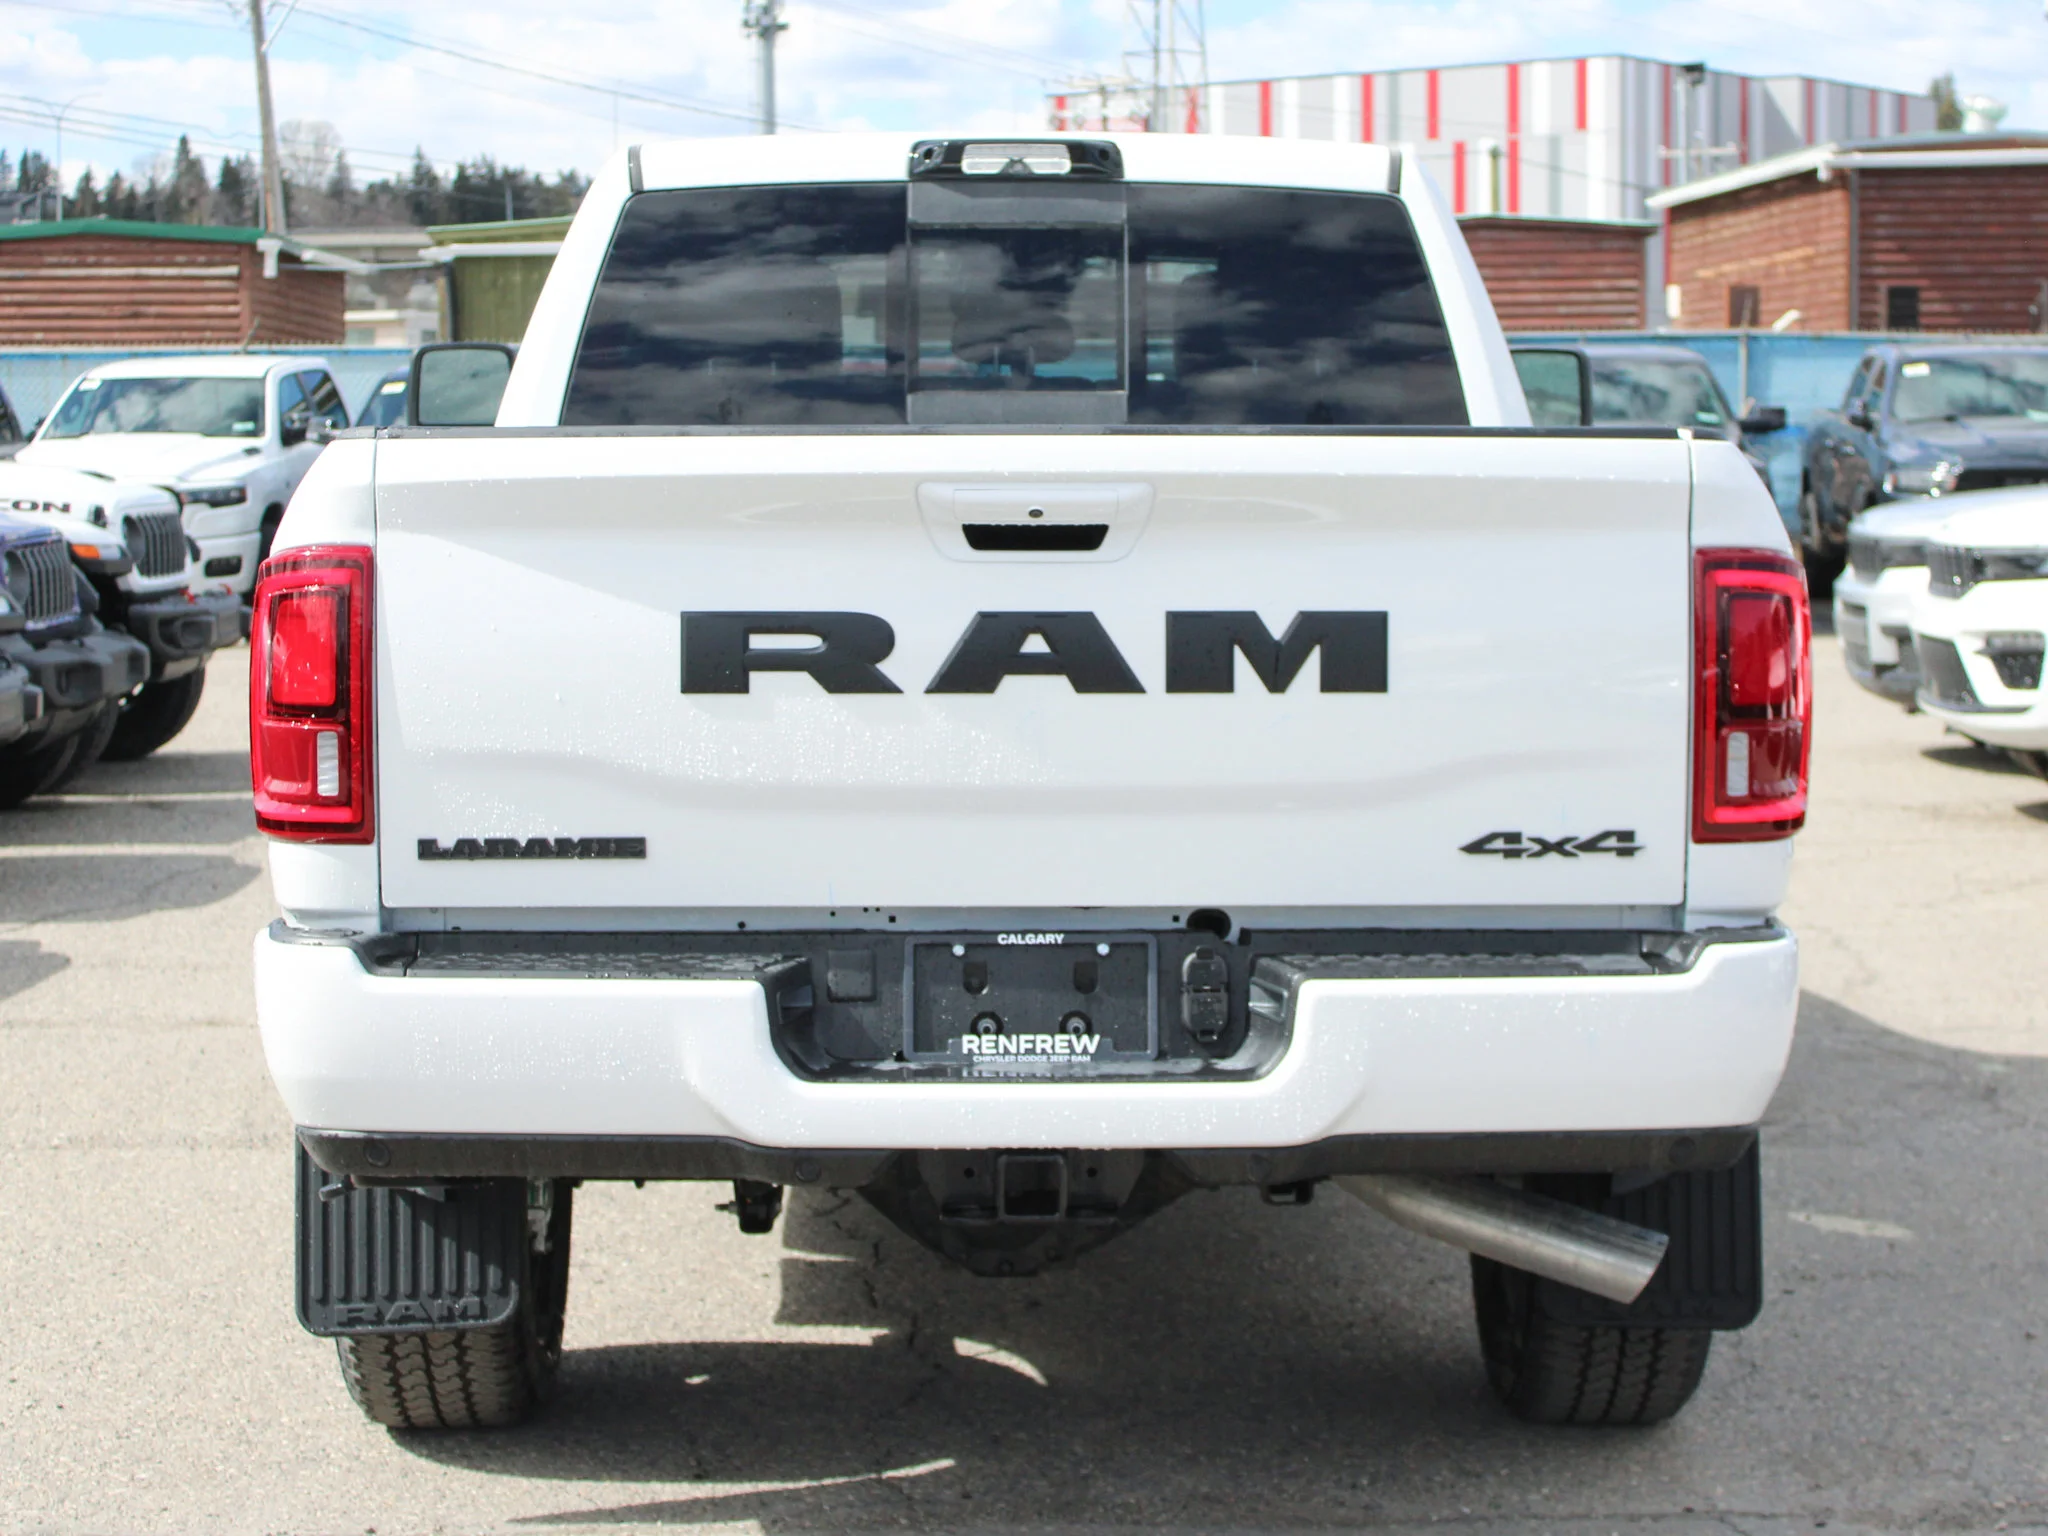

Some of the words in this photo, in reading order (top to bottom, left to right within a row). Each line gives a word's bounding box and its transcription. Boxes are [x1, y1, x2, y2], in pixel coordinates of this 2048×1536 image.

[681, 611, 1388, 693] RAM
[417, 837, 646, 860] LARAMIE
[1458, 830, 1646, 859] 4x4
[997, 932, 1065, 945] CALGARY
[961, 1034, 1101, 1054] RENFREW
[973, 1054, 1017, 1062] CHRYSLER
[1018, 1054, 1048, 1062] DODGE
[1049, 1054, 1070, 1062] JEEP
